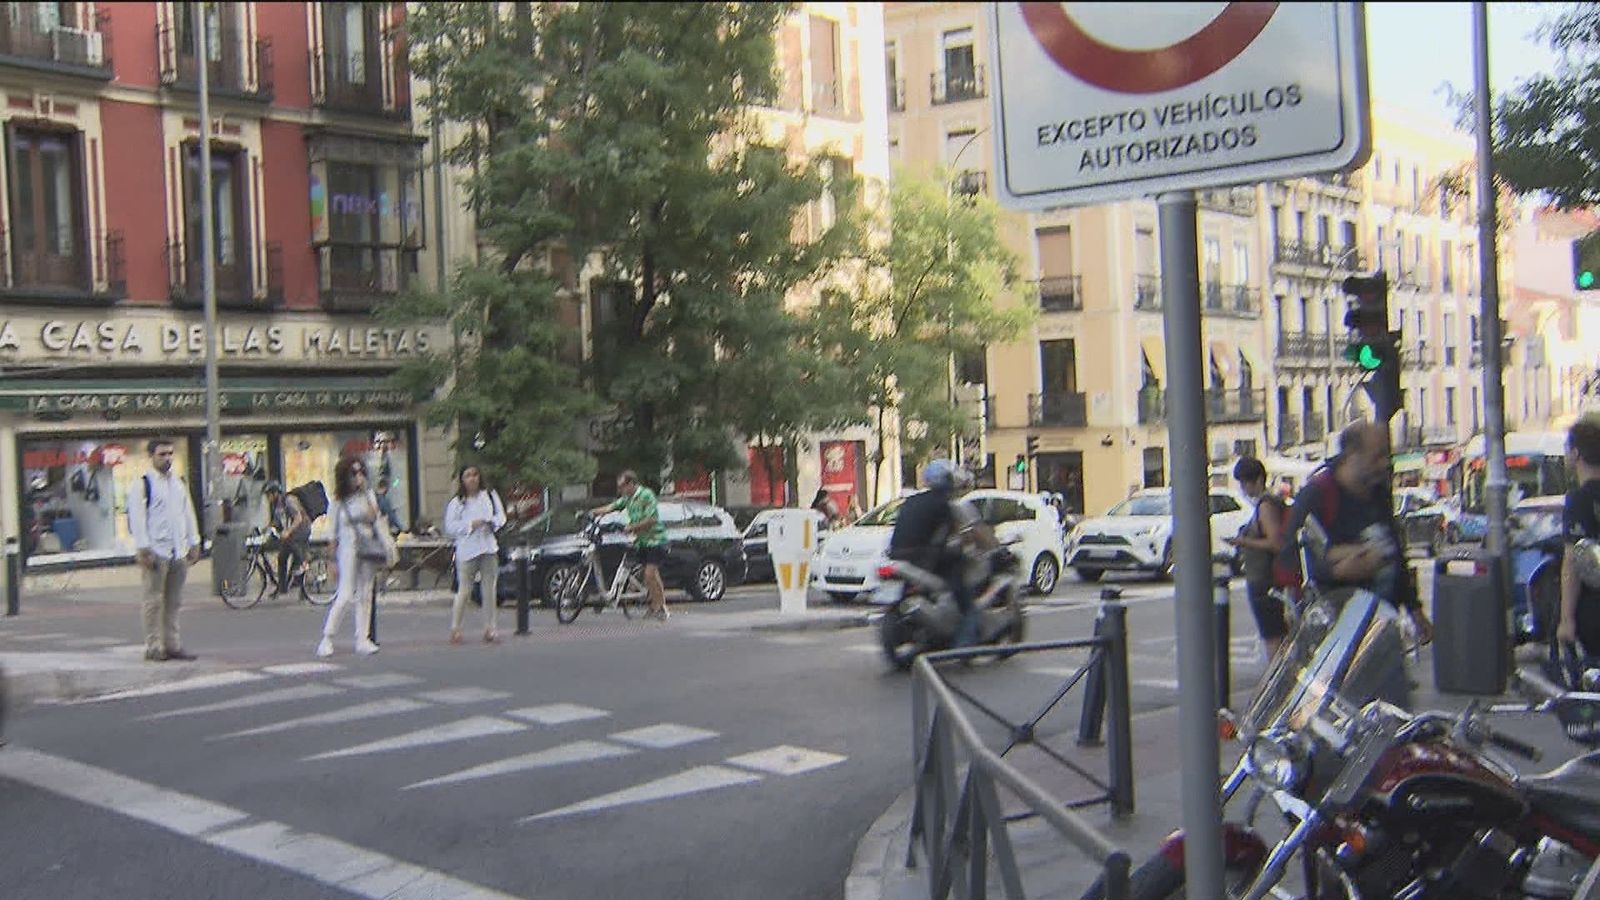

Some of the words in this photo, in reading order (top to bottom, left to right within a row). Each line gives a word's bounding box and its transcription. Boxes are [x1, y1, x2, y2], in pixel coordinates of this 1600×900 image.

[1037, 108, 1146, 148] EXCEPTO
[1153, 83, 1303, 127] VEHÍCULOS
[1078, 126, 1257, 173] AUTORIZADOS
[41, 320, 143, 352] CASA
[161, 322, 202, 352] DE
[222, 325, 284, 353] LAS
[303, 327, 430, 354] MALETAS
